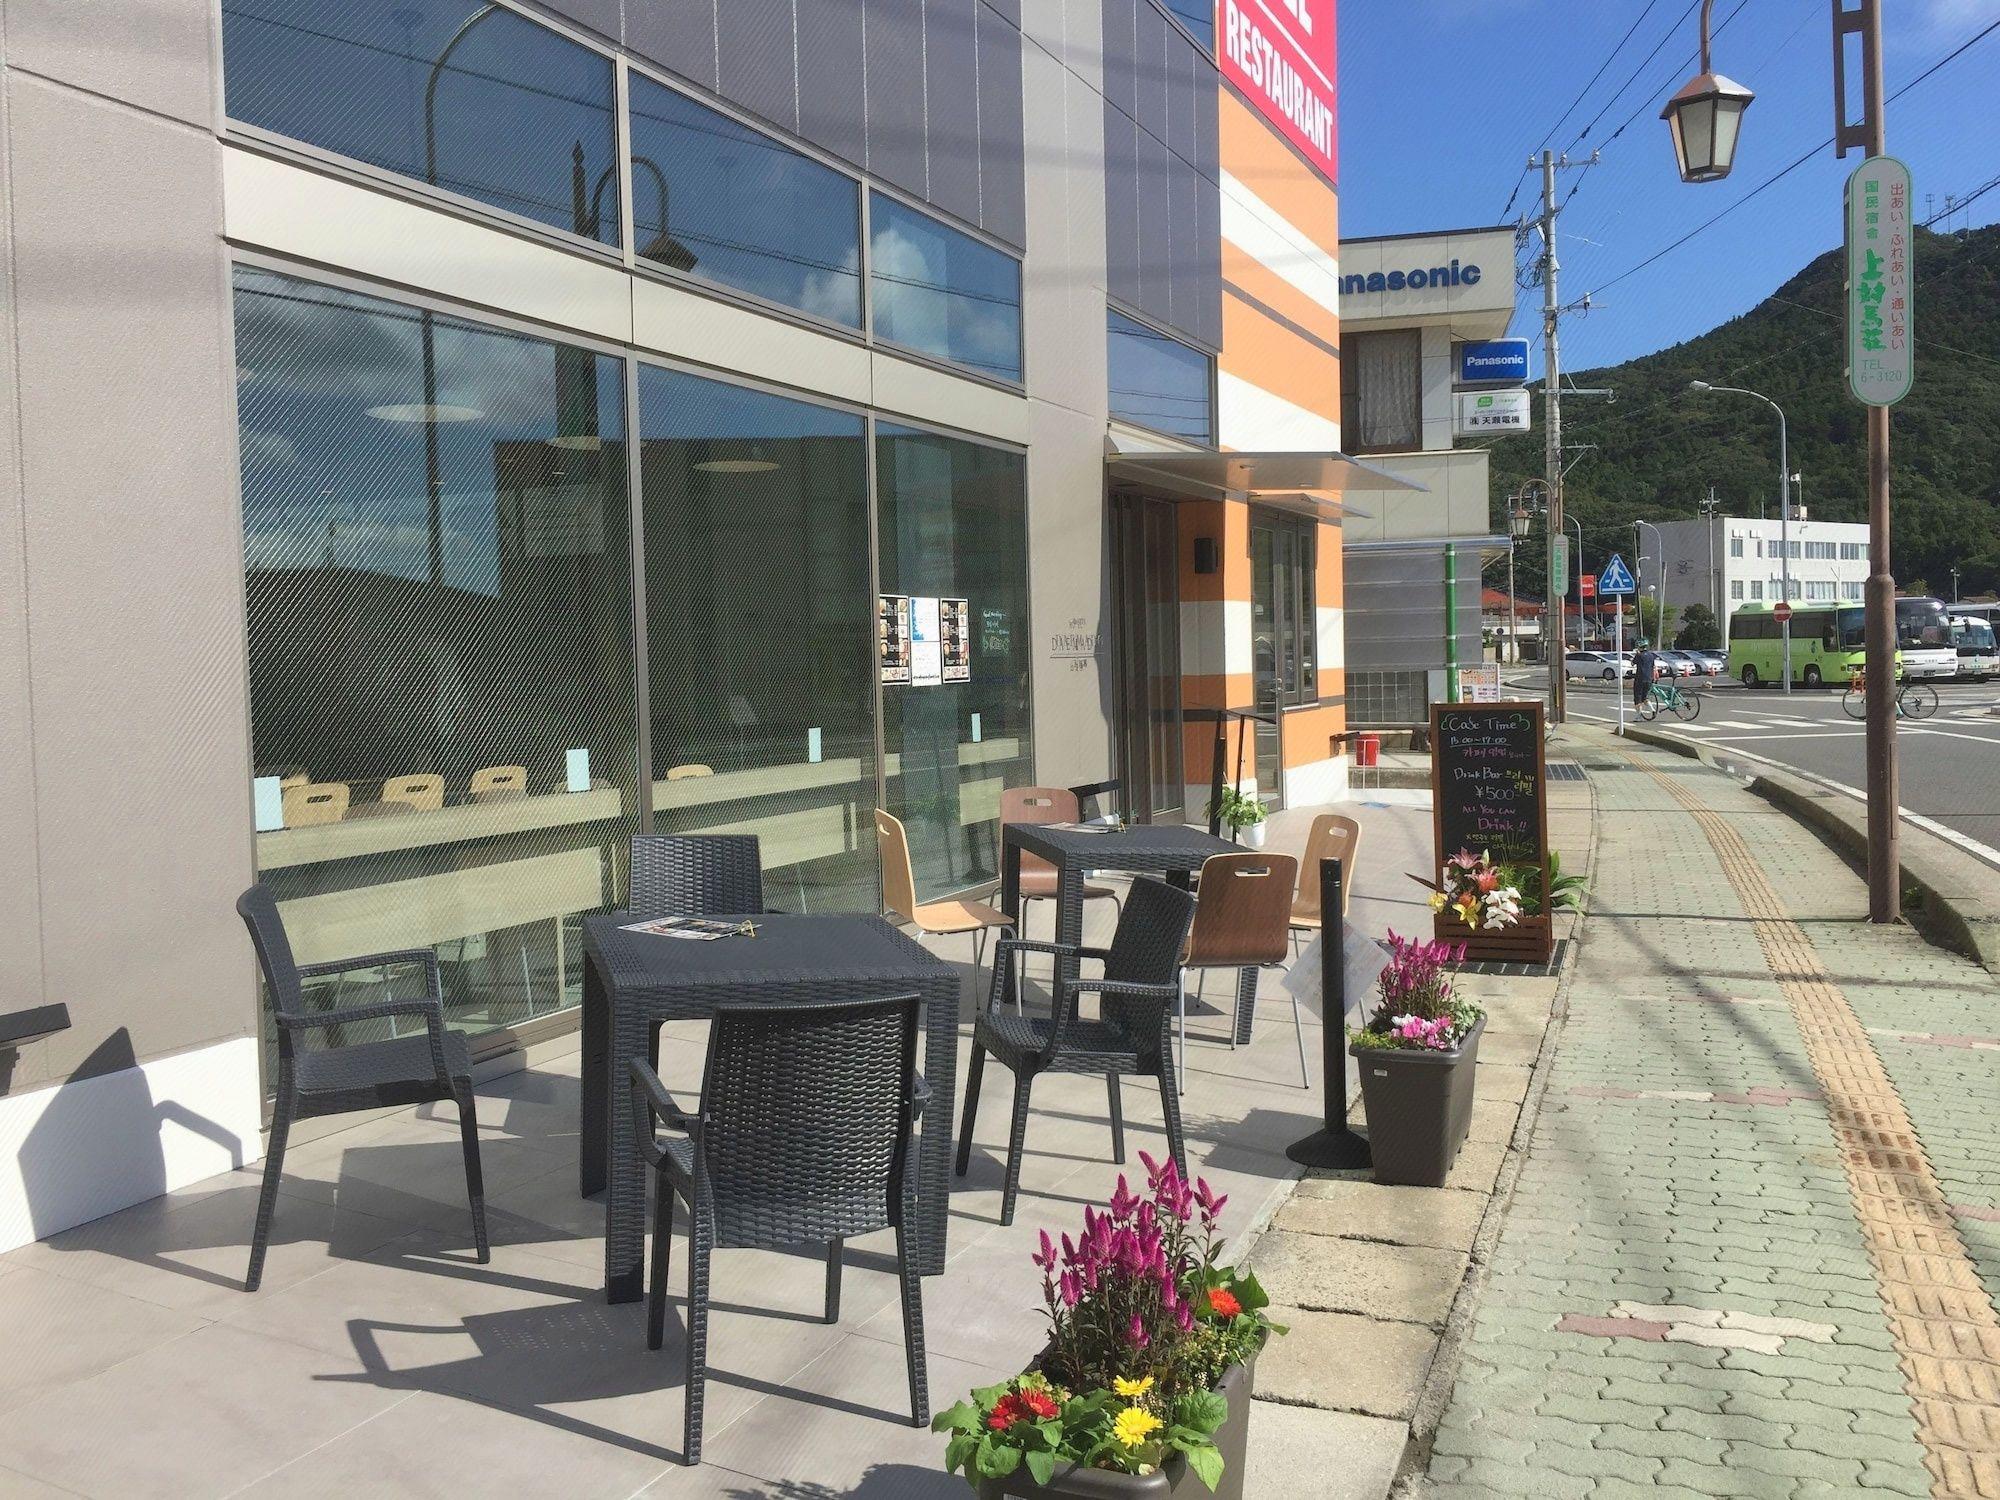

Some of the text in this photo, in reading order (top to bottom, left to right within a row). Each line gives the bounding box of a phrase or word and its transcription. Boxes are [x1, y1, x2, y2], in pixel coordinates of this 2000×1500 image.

[1226, 0, 1333, 160] RESTAURANT
[1339, 259, 1481, 296] nasonic
[1467, 355, 1524, 366] Panasonic
[1861, 360, 1885, 370] TEL
[1449, 716, 1517, 731] Cafe Time
[1454, 766, 1503, 780] Drink Bar
[1478, 817, 1513, 831] Drink
